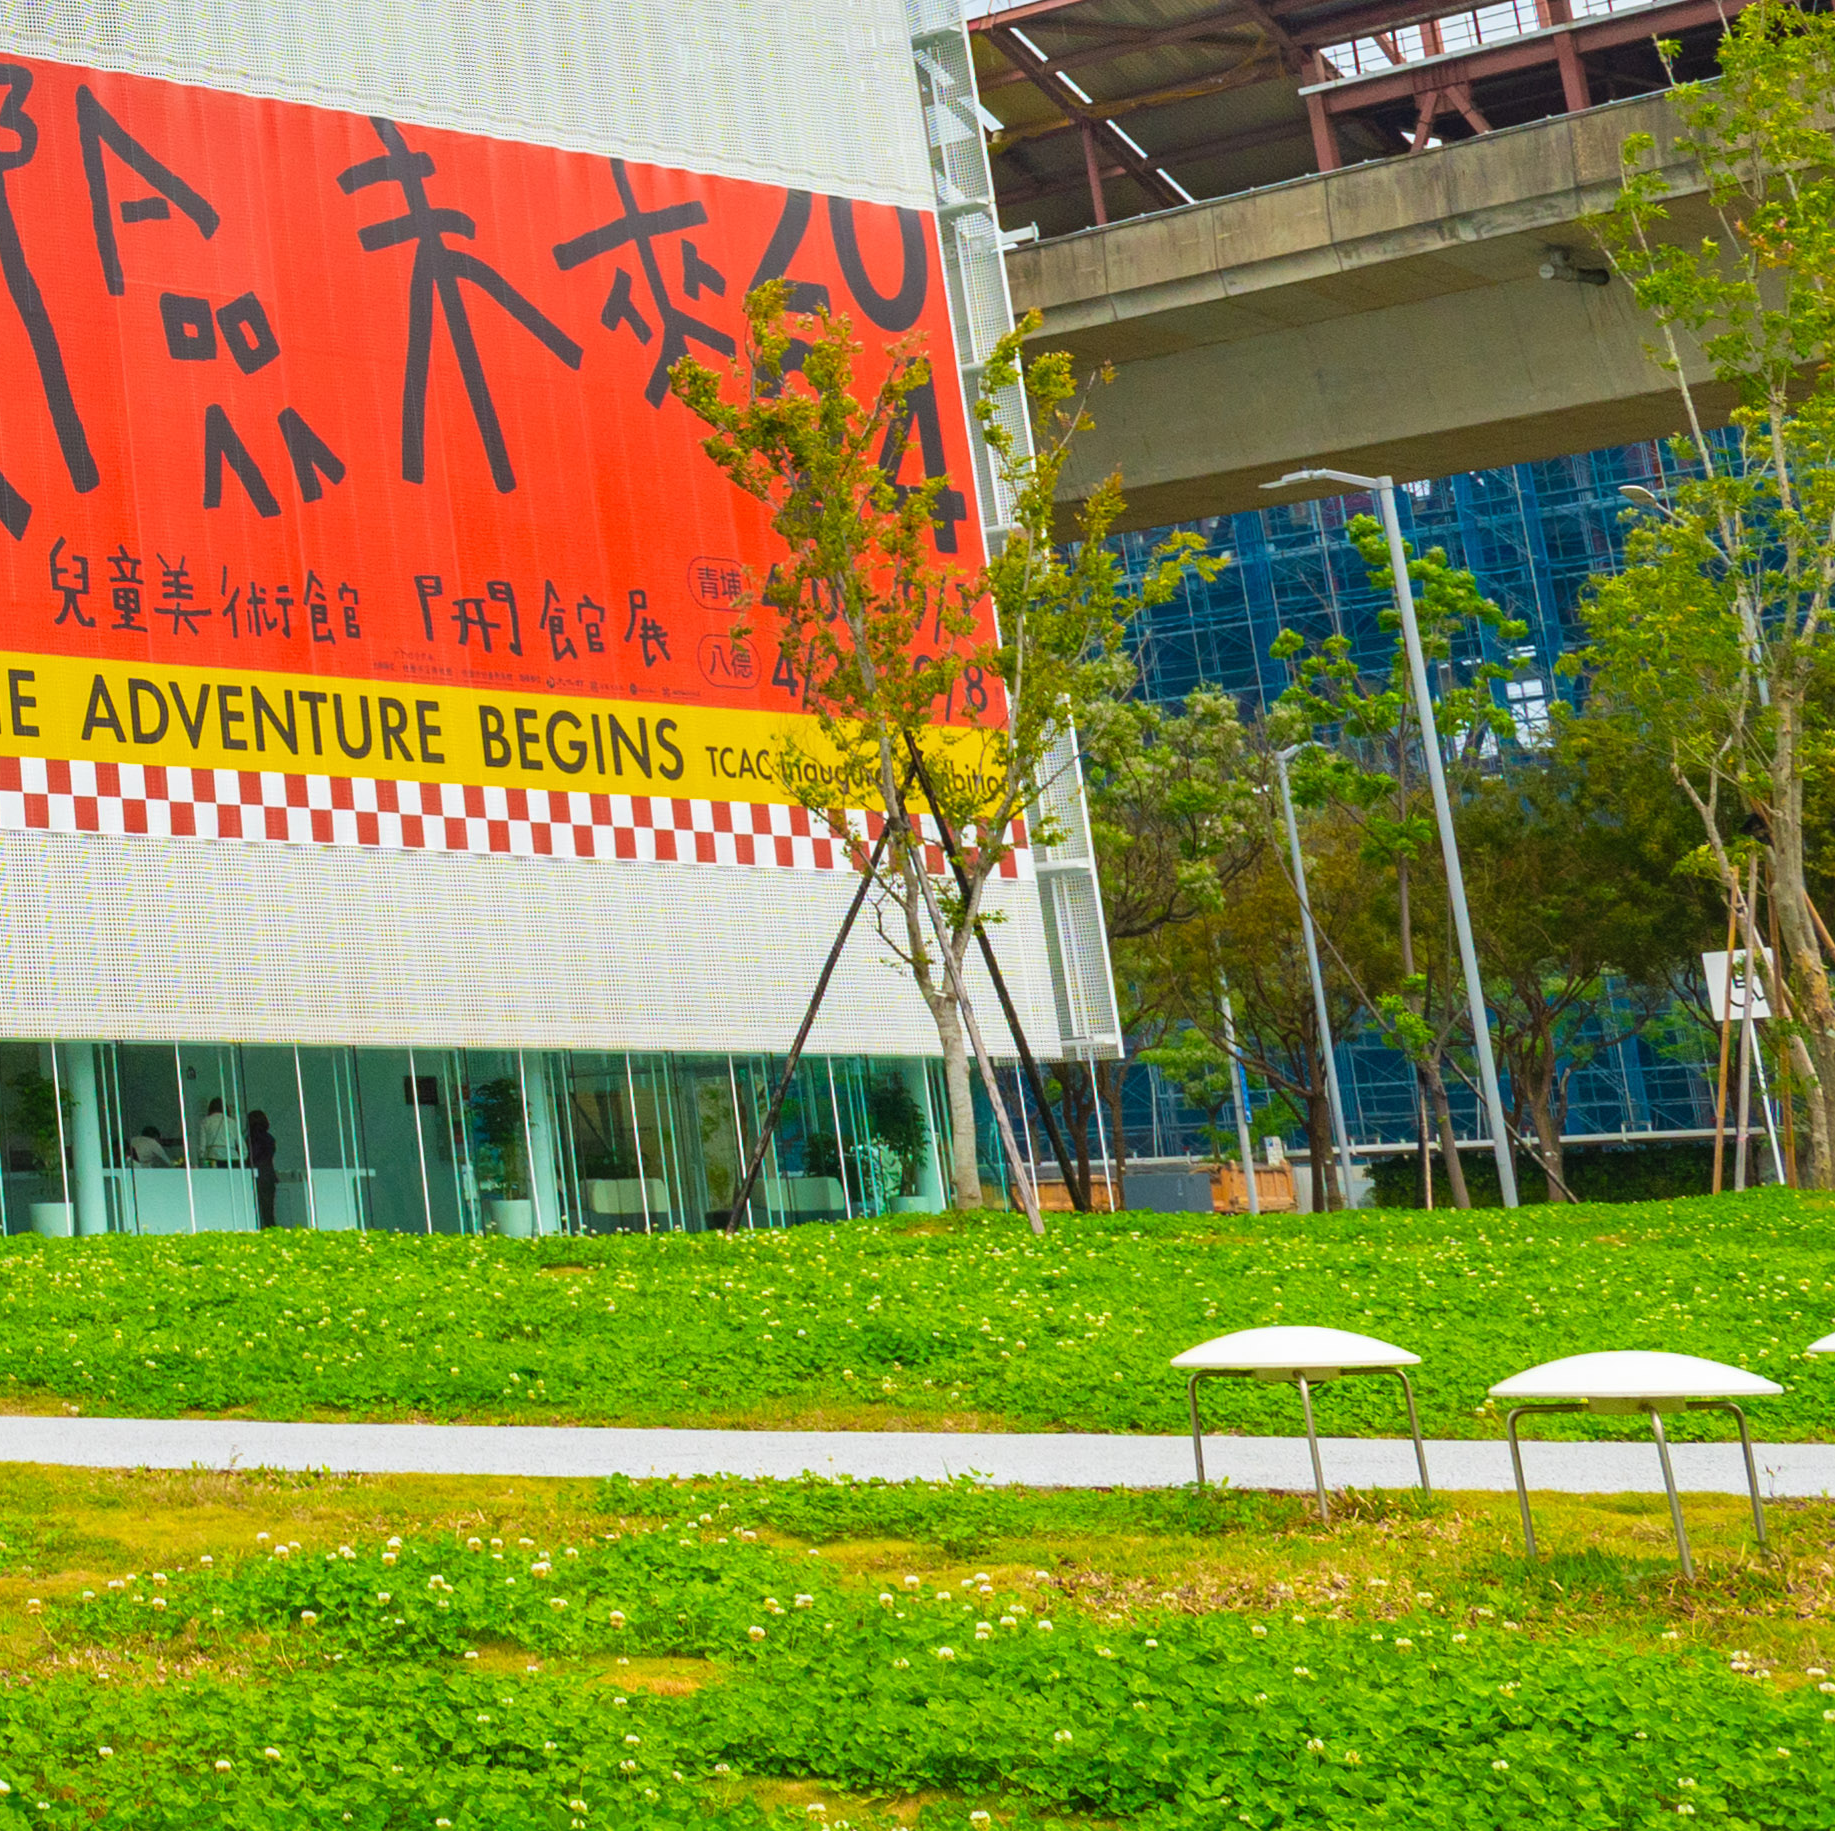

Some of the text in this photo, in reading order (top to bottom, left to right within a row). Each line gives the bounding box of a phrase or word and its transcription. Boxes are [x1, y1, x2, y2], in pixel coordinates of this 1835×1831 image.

[50, 536, 361, 645] 兒童美術館
[414, 574, 672, 667] 開館展
[697, 565, 742, 601] 青埔
[709, 644, 752, 679] 八德
[81, 674, 446, 765] ADVENTURE
[479, 705, 685, 781] BEGINS
[705, 746, 773, 781] TCAC
